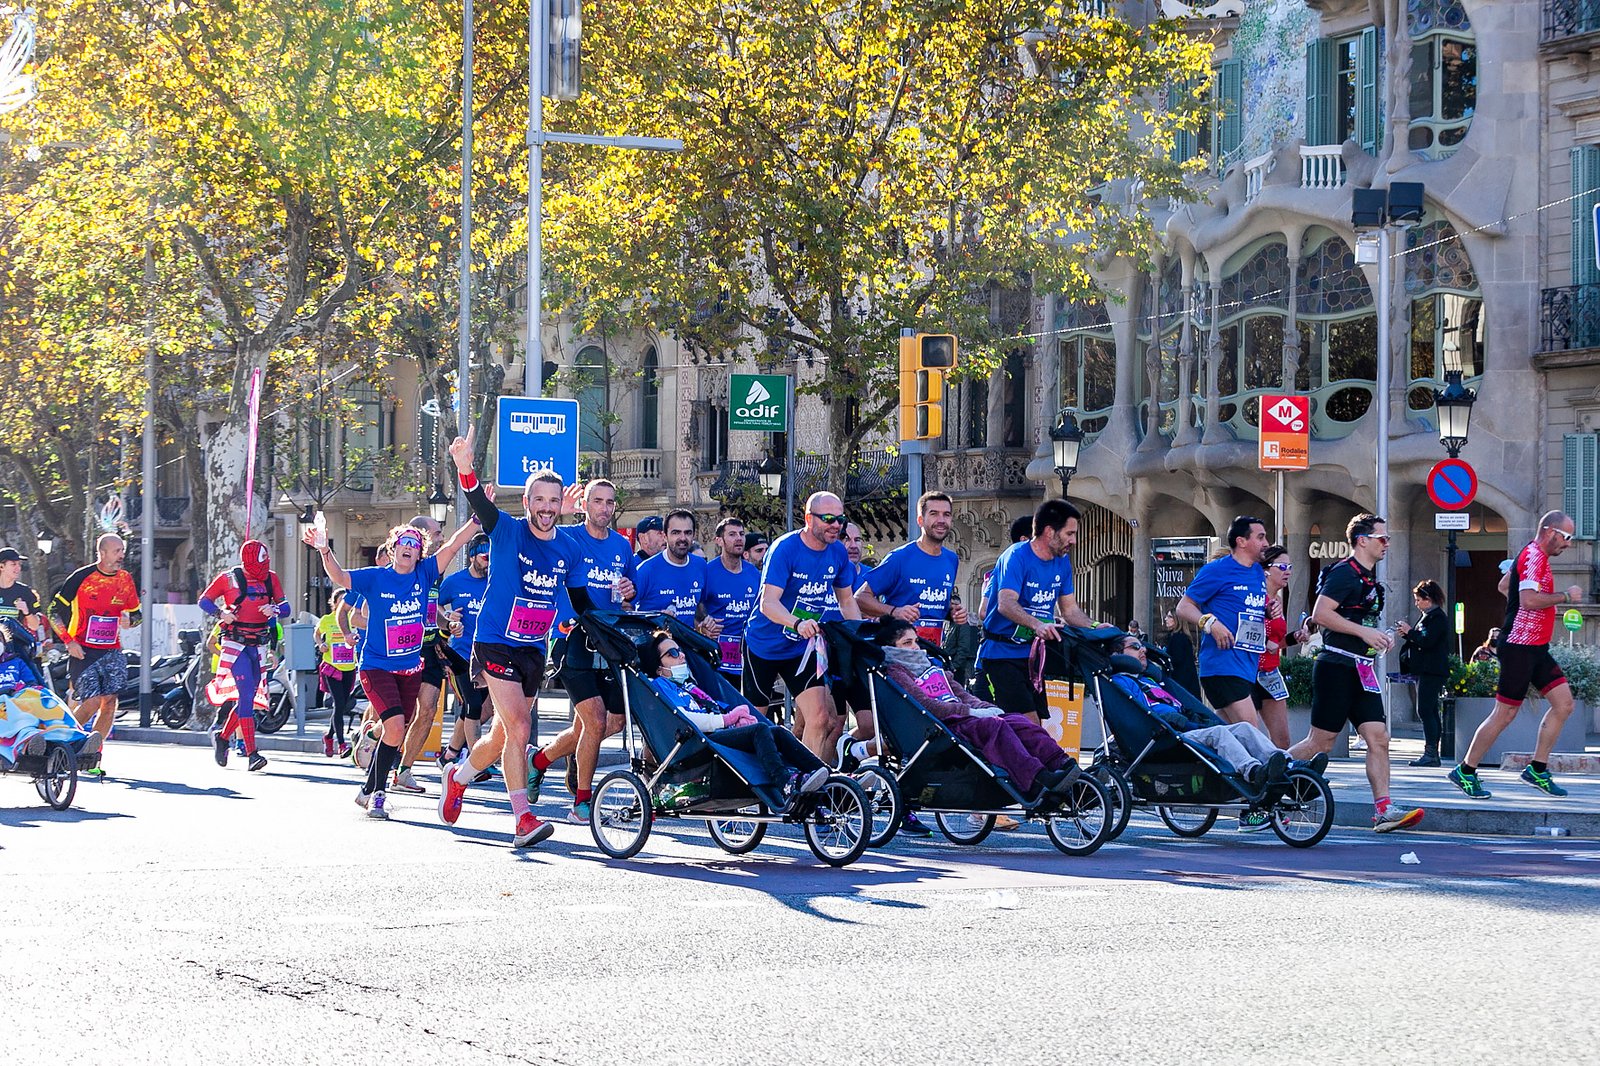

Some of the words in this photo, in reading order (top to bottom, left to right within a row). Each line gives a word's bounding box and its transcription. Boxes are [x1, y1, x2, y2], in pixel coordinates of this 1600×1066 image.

[736, 404, 780, 418] adif
[1279, 405, 1292, 418] M
[1270, 444, 1278, 453] R
[1281, 447, 1307, 455] Rodalies
[522, 456, 554, 473] taxi
[1157, 566, 1183, 582] Shiva
[516, 619, 547, 631] 15173
[397, 634, 417, 645] 882
[1245, 631, 1262, 642] 1157
